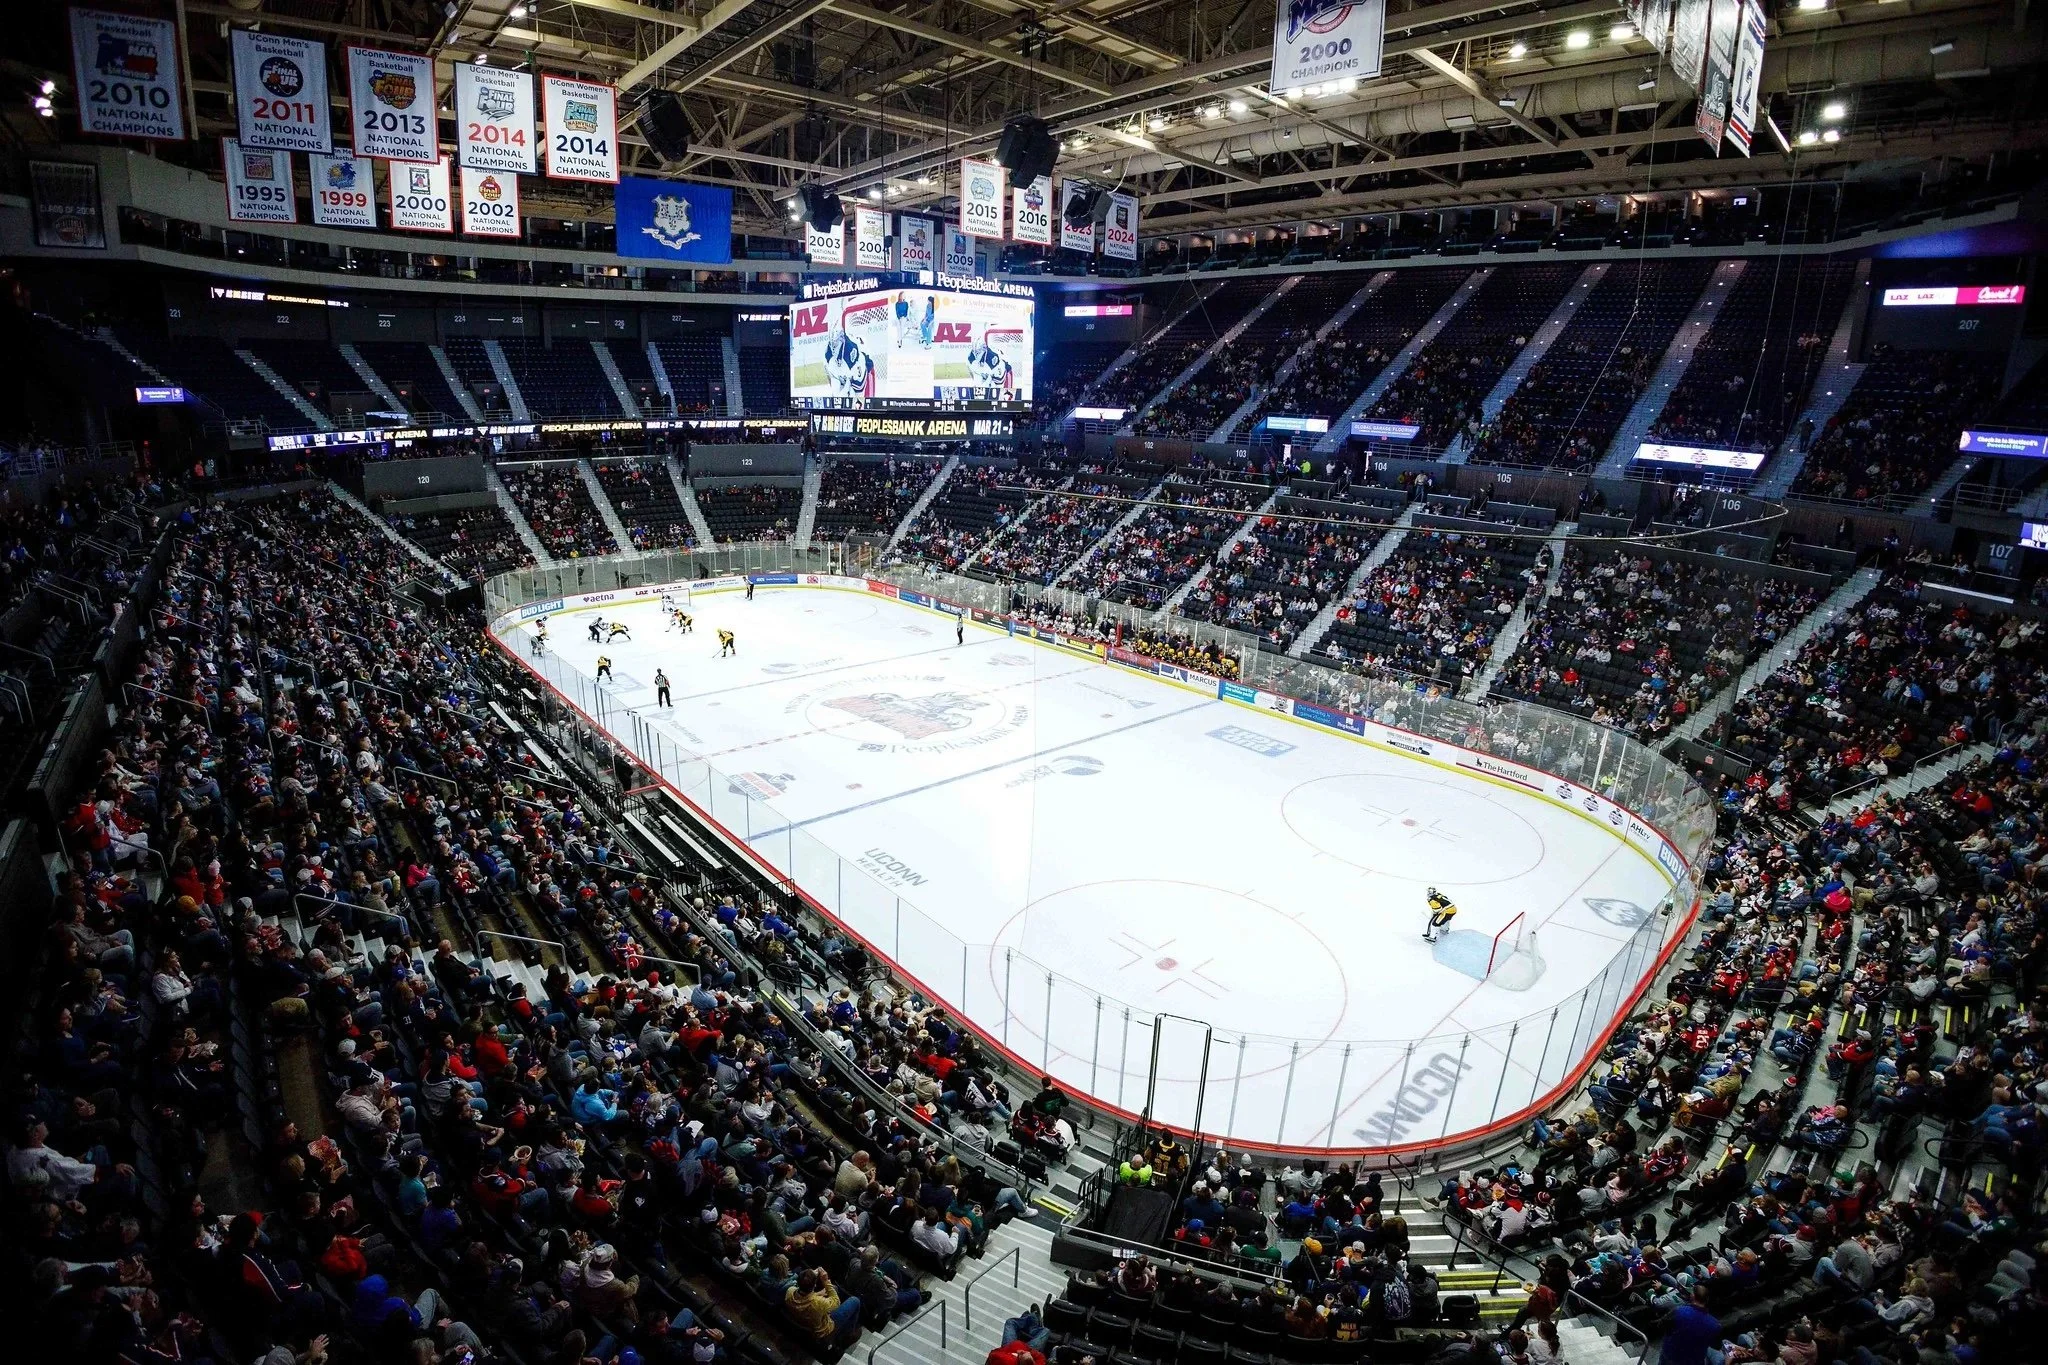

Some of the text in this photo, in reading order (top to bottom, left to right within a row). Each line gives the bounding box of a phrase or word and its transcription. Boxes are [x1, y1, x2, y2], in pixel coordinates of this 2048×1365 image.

[248, 34, 309, 49] UConn Men's
[255, 44, 304, 58] Basketball
[355, 49, 426, 65] UConn Women's
[1300, 38, 1352, 63] 2000
[271, 64, 298, 76] FINAL
[369, 60, 413, 72] Basketball
[469, 66, 520, 80] UConn Men's
[1291, 58, 1359, 79] CHAMPIONS
[262, 71, 298, 87] FOUR
[475, 76, 515, 88] Basketball
[550, 79, 609, 94] UConn Women's
[89, 80, 170, 108] 2010
[561, 89, 599, 100] Basketball
[97, 107, 167, 122] NATIONAL
[253, 98, 315, 124] 2011
[92, 120, 174, 136] CHAMPIONS
[363, 110, 426, 135] 2013
[254, 123, 317, 137] NATIONAL
[468, 123, 526, 147] 2014
[250, 135, 323, 150] CHAMPIONS
[368, 134, 424, 147] NATIONAL
[555, 135, 609, 157] 2014
[363, 145, 430, 160] CHAMPIONS
[472, 145, 524, 159] NATIONAL
[468, 155, 528, 170] CHAMPIONS
[559, 155, 607, 168] NATIONAL
[555, 166, 611, 179] CHAMPIONS
[236, 185, 286, 202] 1995
[319, 190, 367, 208] 1999
[240, 203, 285, 212] NATIONAL
[395, 194, 446, 212] 2000
[468, 202, 514, 218] 2002
[237, 211, 290, 221] CHAMPIONS
[323, 208, 366, 217] NATIONAL
[402, 212, 441, 221] NATIONAL
[966, 203, 997, 219] 2015
[1018, 210, 1047, 226] 2016
[321, 216, 370, 225] CHAMPIONS
[399, 219, 446, 229] CHAMPIONS
[473, 217, 510, 226] NATIONAL
[968, 218, 997, 228] NATIONAL
[470, 225, 514, 234] CHAMPIONS
[965, 227, 999, 236] CHAMPIONS
[1020, 225, 1046, 235] NATIONAL
[1108, 229, 1135, 244] 2024
[809, 235, 841, 249] 2003
[1017, 233, 1048, 242] CHAMPIONS
[1067, 234, 1090, 243] NATIONAL
[1064, 241, 1092, 250] CHAMPIONS
[1110, 242, 1132, 252] NATIONAL
[903, 248, 931, 261] 2004
[947, 254, 973, 266] 2009
[1108, 249, 1134, 259] CHAMPIONS
[813, 278, 878, 299] PeoplesBank ARENA
[937, 271, 1034, 297] PeoplesBank ARENA
[169, 309, 181, 317] 221
[277, 315, 289, 323] 222
[378, 320, 390, 328] 223
[1959, 320, 1980, 330] 207
[542, 423, 611, 432] PEOPLESBANK
[612, 422, 643, 430] ARENA
[857, 418, 925, 436] PEOPLESBANK
[927, 420, 967, 435] ARENA
[973, 420, 991, 435] MAR
[992, 420, 1001, 435] 21
[395, 430, 428, 439] ARENA
[1144, 441, 1154, 449] 102
[1236, 450, 1246, 458] 103
[1374, 462, 1388, 471] 104
[418, 476, 430, 484] 120
[1496, 473, 1512, 484] 105
[1722, 499, 1741, 511] 106
[1989, 543, 2014, 558] 107
[590, 593, 615, 602] aetna
[522, 601, 563, 618] BUD LIGHT
[1189, 673, 1217, 687] MARCUS
[1483, 761, 1528, 781] The Hartford
[1661, 844, 1679, 873] BUD
[856, 857, 903, 887] HEALTH
[864, 848, 928, 886] UCONN
[1353, 1052, 1473, 1146] UCONN
